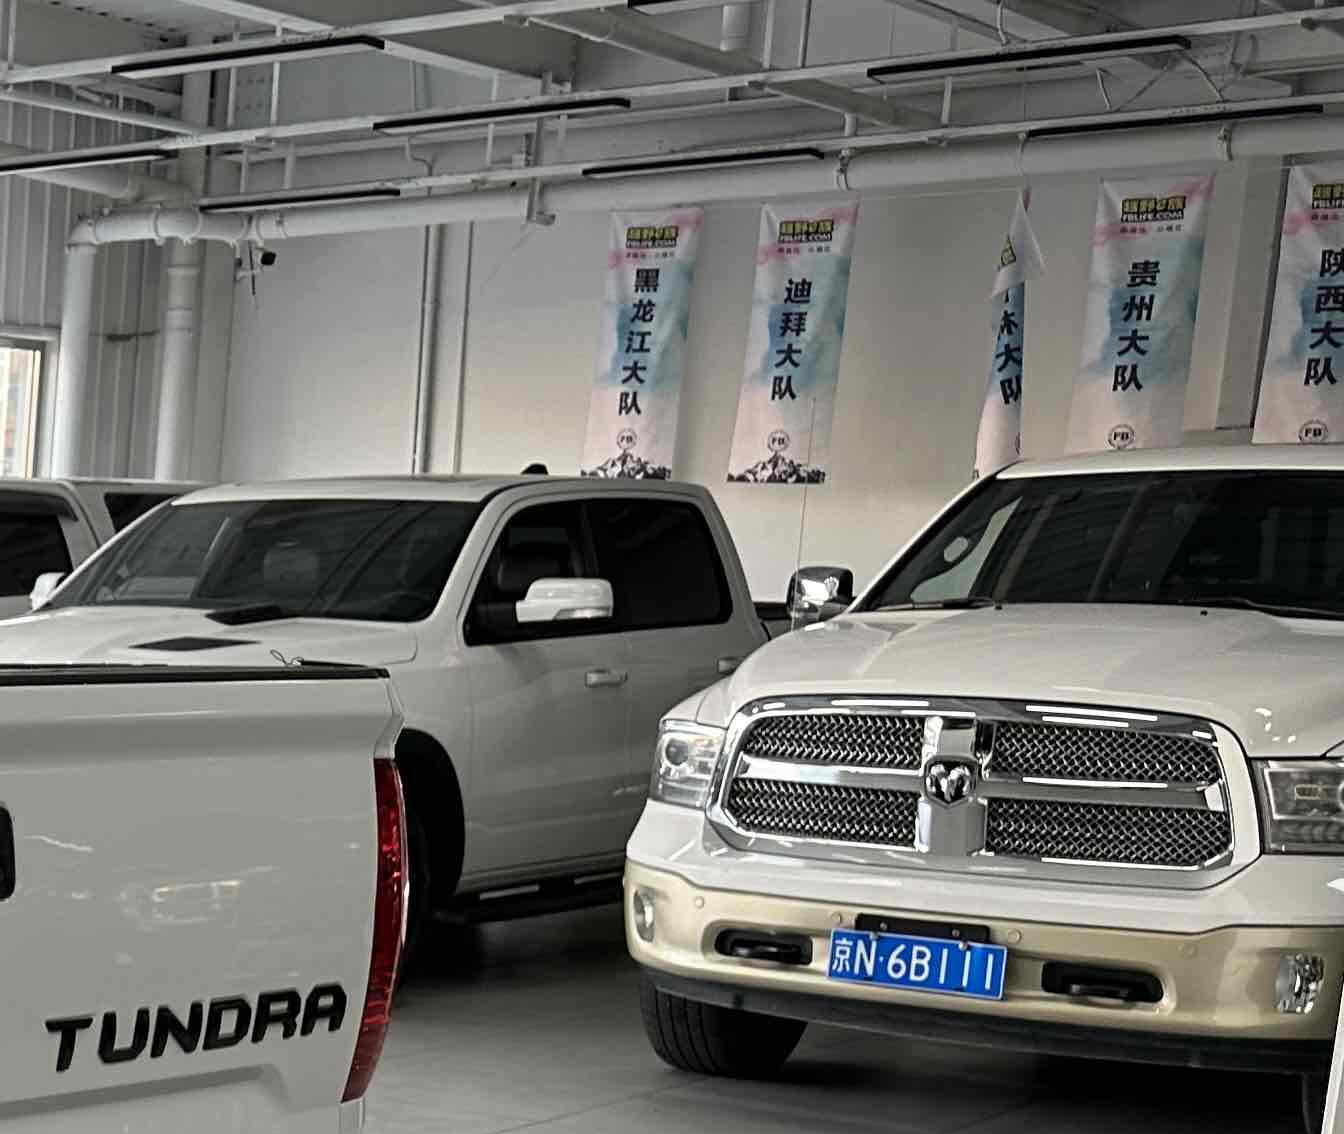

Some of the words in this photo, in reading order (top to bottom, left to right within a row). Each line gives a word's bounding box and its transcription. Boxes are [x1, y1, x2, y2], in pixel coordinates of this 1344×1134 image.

[618, 268, 660, 416] 黑龙江大队
[771, 278, 813, 401] 迪拜大队
[1112, 259, 1161, 392] 贵州大队
[45, 983, 347, 1073] TUNDRA
